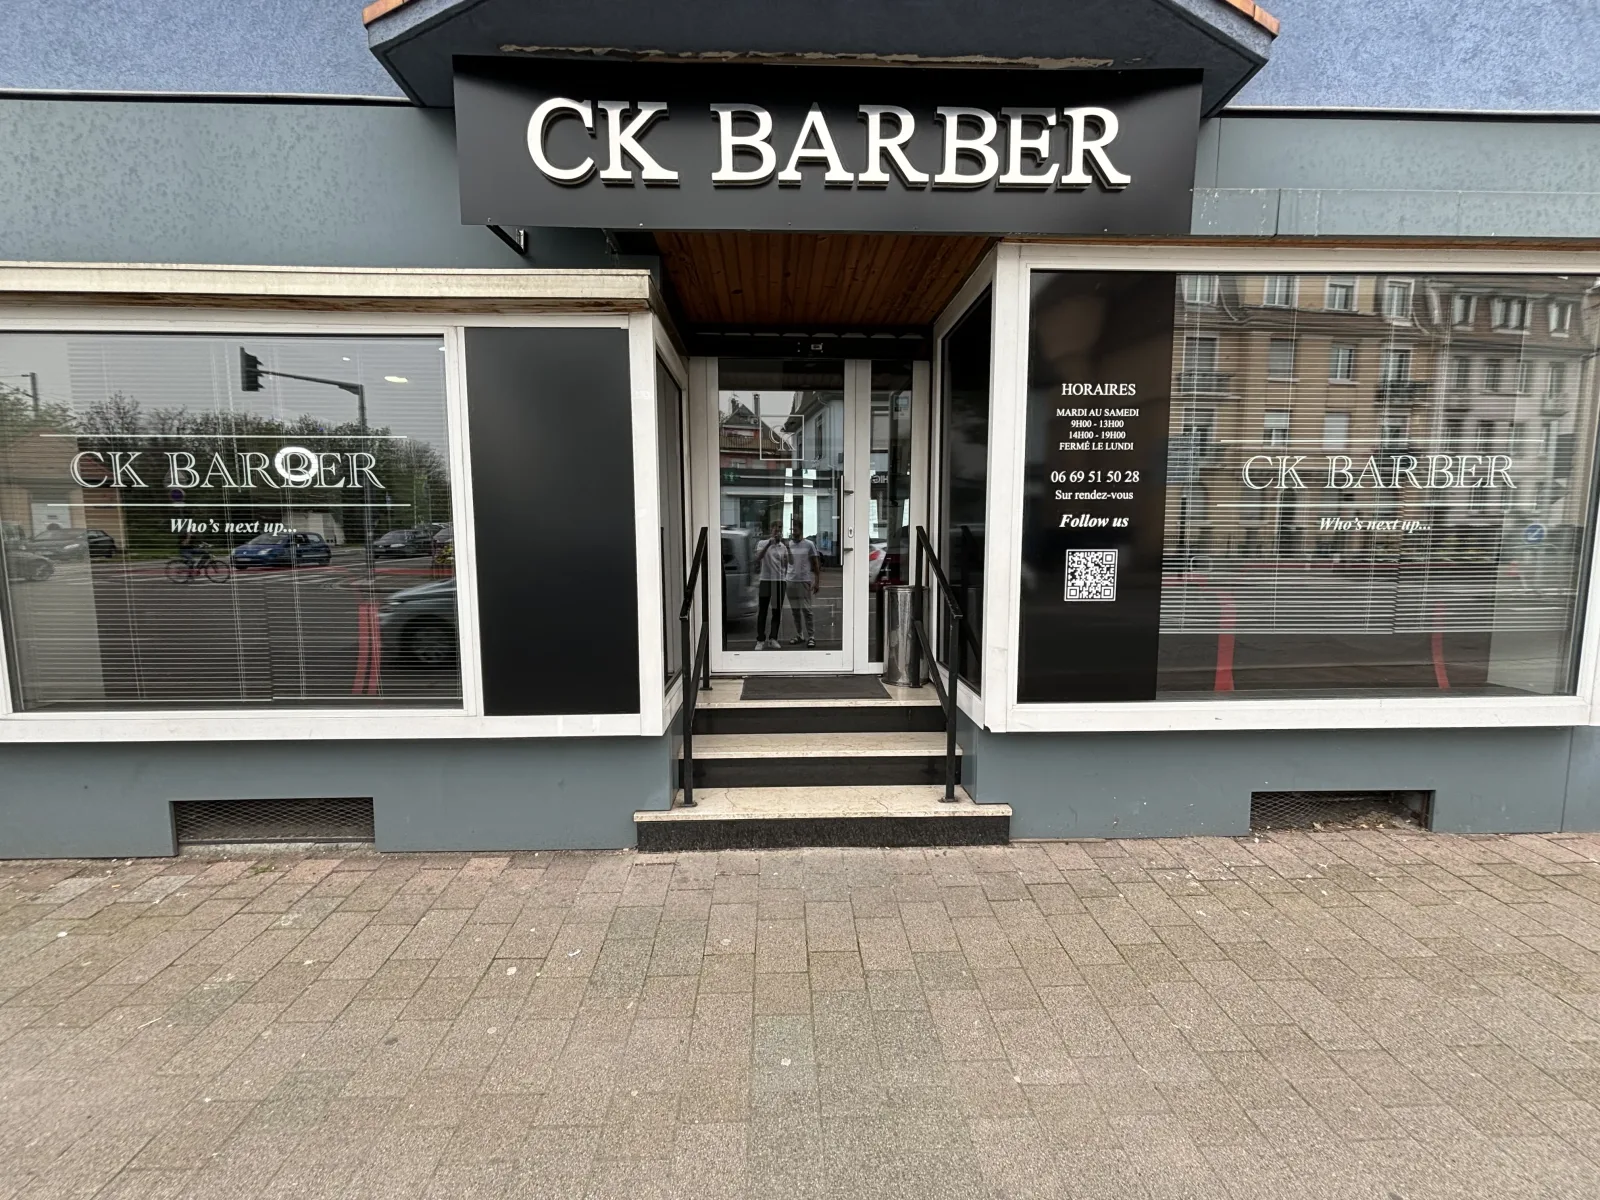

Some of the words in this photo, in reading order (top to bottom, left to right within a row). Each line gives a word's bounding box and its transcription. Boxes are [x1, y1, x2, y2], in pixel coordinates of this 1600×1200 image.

[526, 96, 680, 188] CK
[709, 102, 1132, 191] BARBER
[1061, 383, 1136, 396] HORAIRES
[1056, 408, 1087, 417] MARDI
[1088, 408, 1102, 417] AU
[1104, 408, 1139, 417] SAMEDI
[1070, 420, 1092, 428] 9H00
[1100, 420, 1124, 428] 13H00
[1069, 431, 1094, 439] 14H00
[1101, 431, 1126, 439] 19H00
[1059, 440, 1090, 450] FERMÉ
[1092, 442, 1104, 450] LE
[1105, 442, 1134, 450] LUNDI
[70, 451, 150, 488] CK
[167, 451, 386, 489] BARBER
[1050, 470, 1066, 483] 06
[1069, 470, 1085, 483] 69
[1088, 470, 1102, 483] 51
[1106, 470, 1122, 483] 50
[1124, 470, 1140, 483] 28
[1242, 455, 1307, 489] CK
[1324, 454, 1517, 489] BARBER
[1055, 490, 1073, 500] Sur
[1074, 489, 1134, 500] rendez-vous
[1059, 513, 1109, 528] Follow
[1112, 516, 1129, 528] us
[1367, 518, 1399, 531] next
[1400, 520, 1431, 535] up...
[224, 520, 259, 534] next
[262, 523, 298, 538] up...
